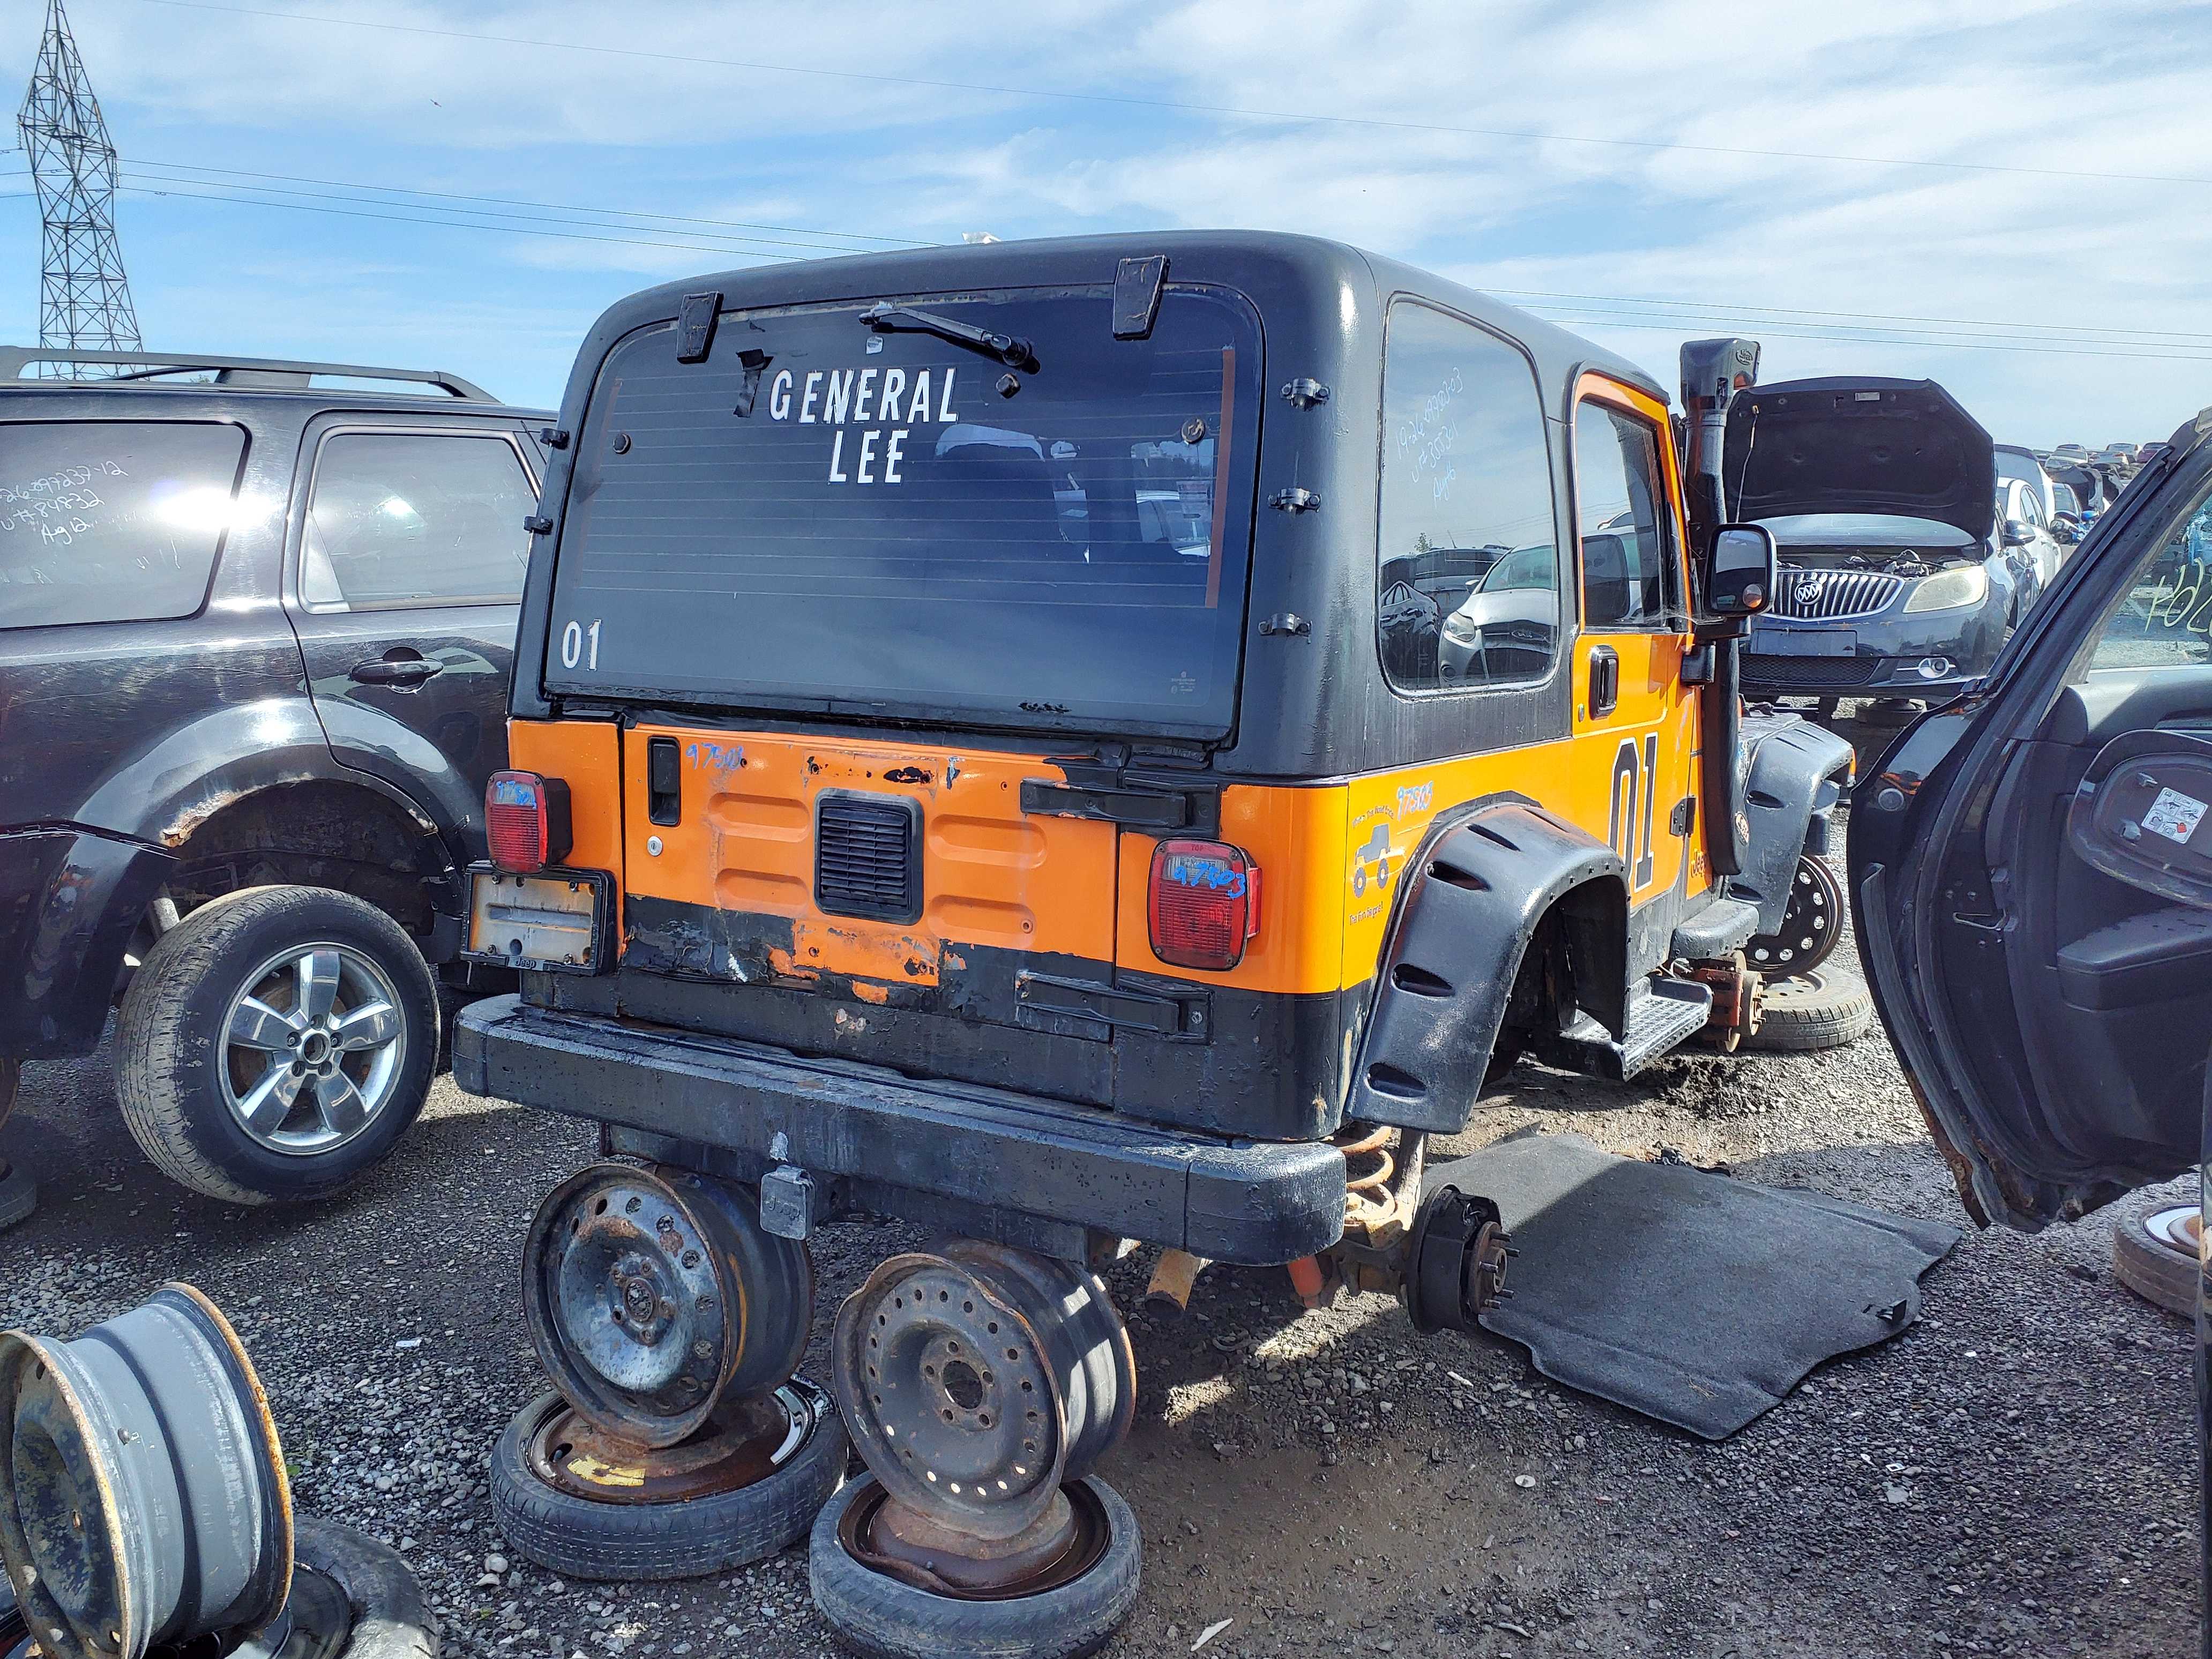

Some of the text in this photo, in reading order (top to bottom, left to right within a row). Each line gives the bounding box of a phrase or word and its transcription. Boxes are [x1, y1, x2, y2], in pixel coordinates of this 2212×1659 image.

[768, 368, 959, 424] GENERAL
[828, 429, 910, 484] LEE
[562, 618, 602, 672] 01
[1608, 731, 1659, 893] 01
[1191, 843, 1205, 851] TOP
[1174, 862, 1245, 899] 97503
[765, 1195, 800, 1221] Jeep
